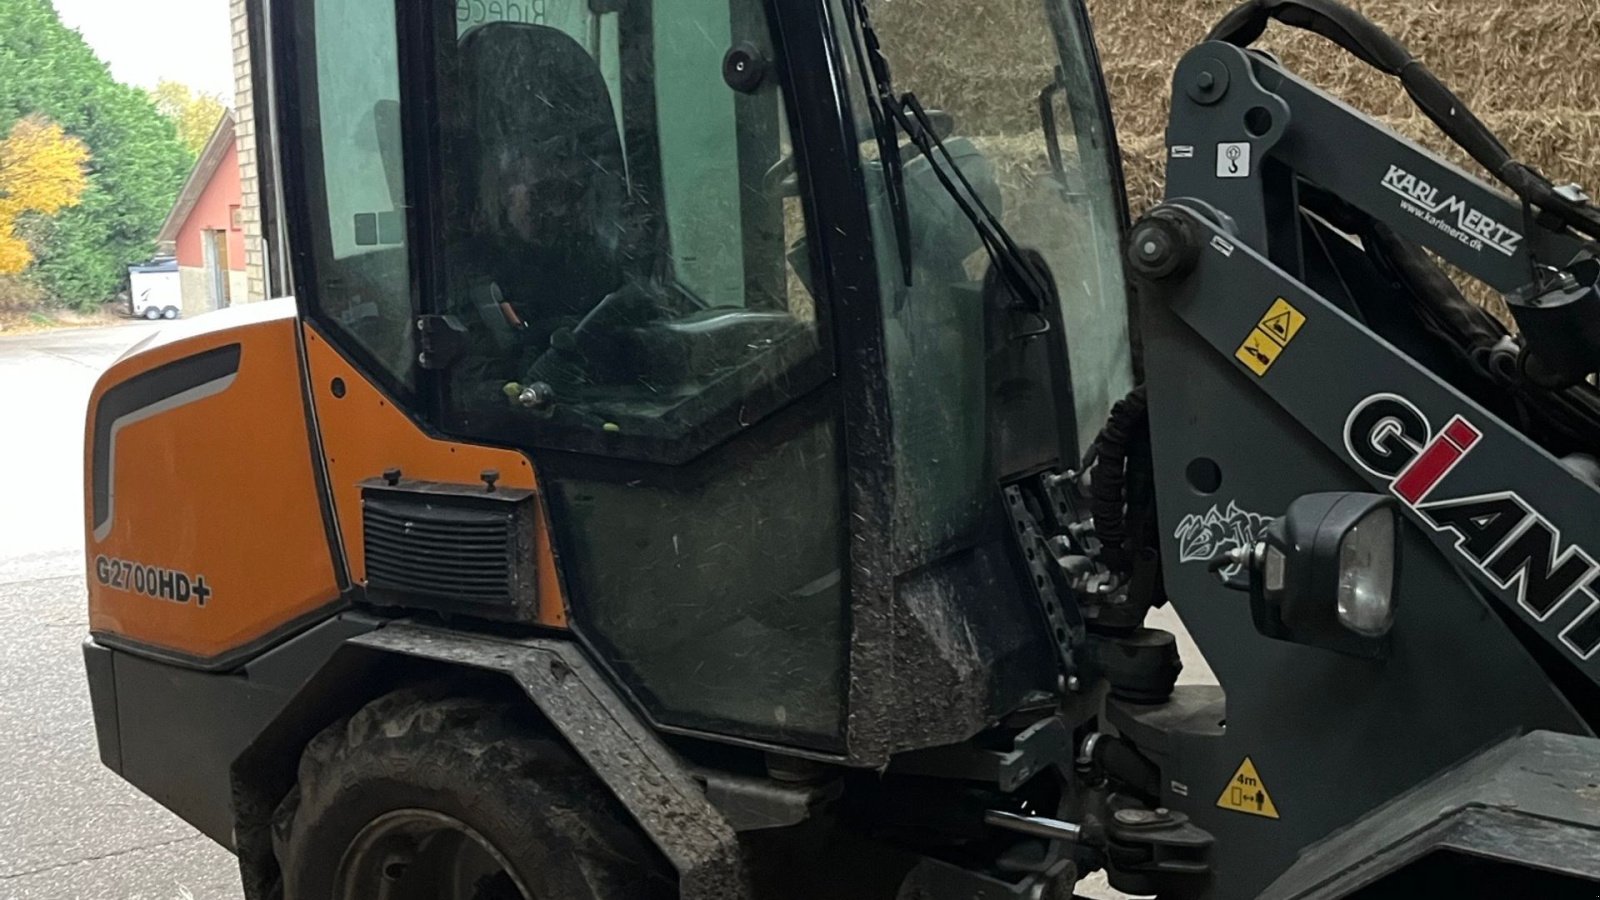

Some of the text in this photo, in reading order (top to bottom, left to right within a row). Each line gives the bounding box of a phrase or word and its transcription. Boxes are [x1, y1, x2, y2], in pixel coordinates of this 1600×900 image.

[1382, 164, 1524, 254] KARL MERTZ
[1400, 200, 1484, 251] www.karlmertz.dk
[95, 555, 212, 607] G2700HD+
[1236, 773, 1257, 787] 4m
